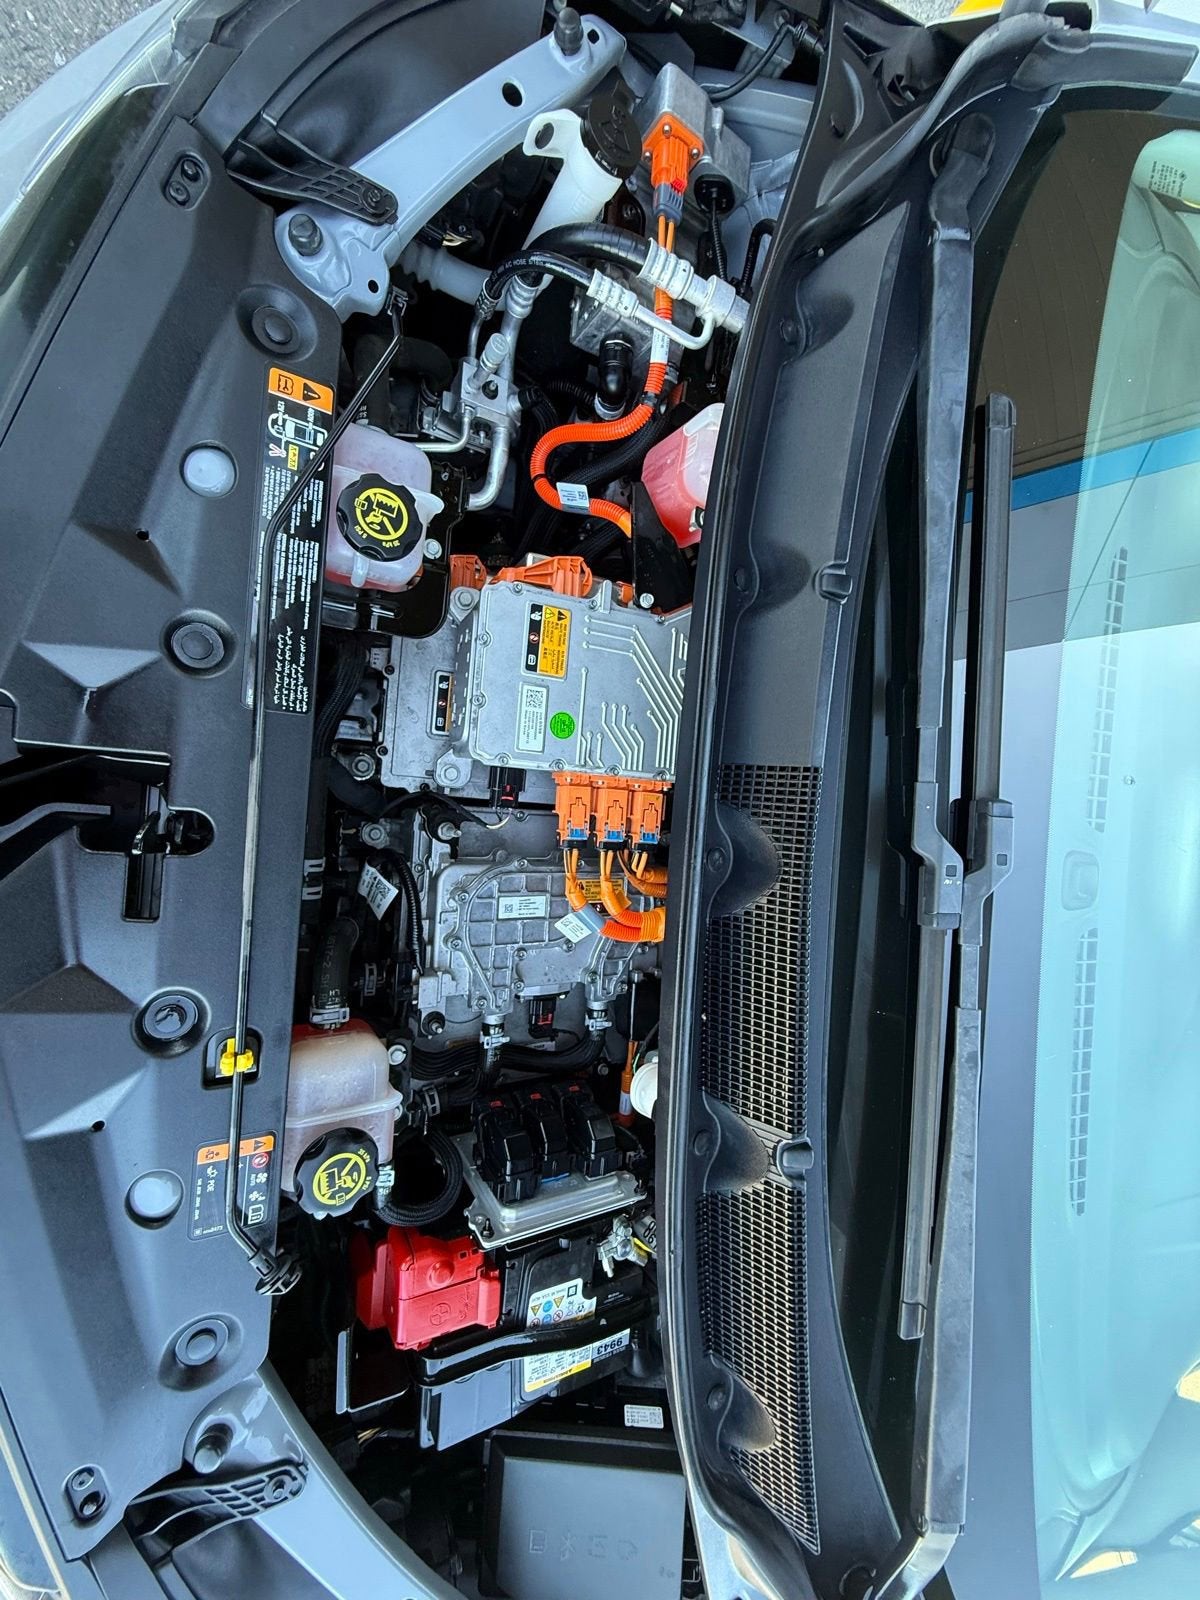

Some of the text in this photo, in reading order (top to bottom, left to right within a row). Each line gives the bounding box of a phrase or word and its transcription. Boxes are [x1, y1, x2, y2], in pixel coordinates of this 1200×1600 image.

[513, 258, 527, 266] HOSE
[277, 401, 285, 412] 12V
[596, 1337, 623, 1355] 9943
